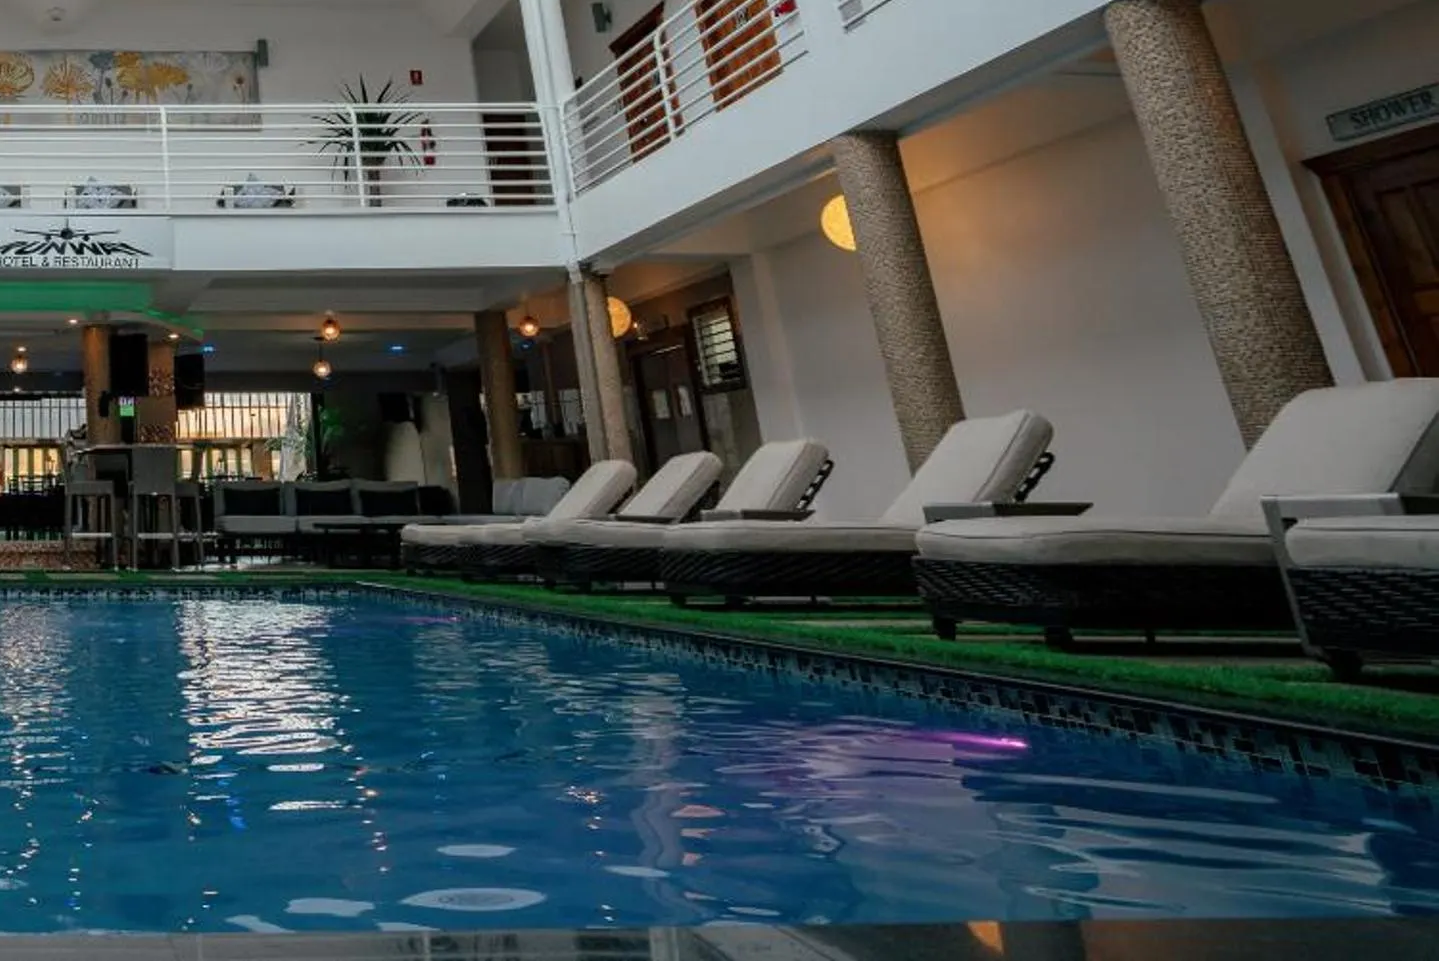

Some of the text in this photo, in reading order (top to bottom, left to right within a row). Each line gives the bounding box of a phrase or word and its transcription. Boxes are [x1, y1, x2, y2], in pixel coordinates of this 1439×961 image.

[1350, 91, 1434, 129] SHOWER
[41, 257, 50, 267] &
[54, 256, 140, 267] RESTAURANT
